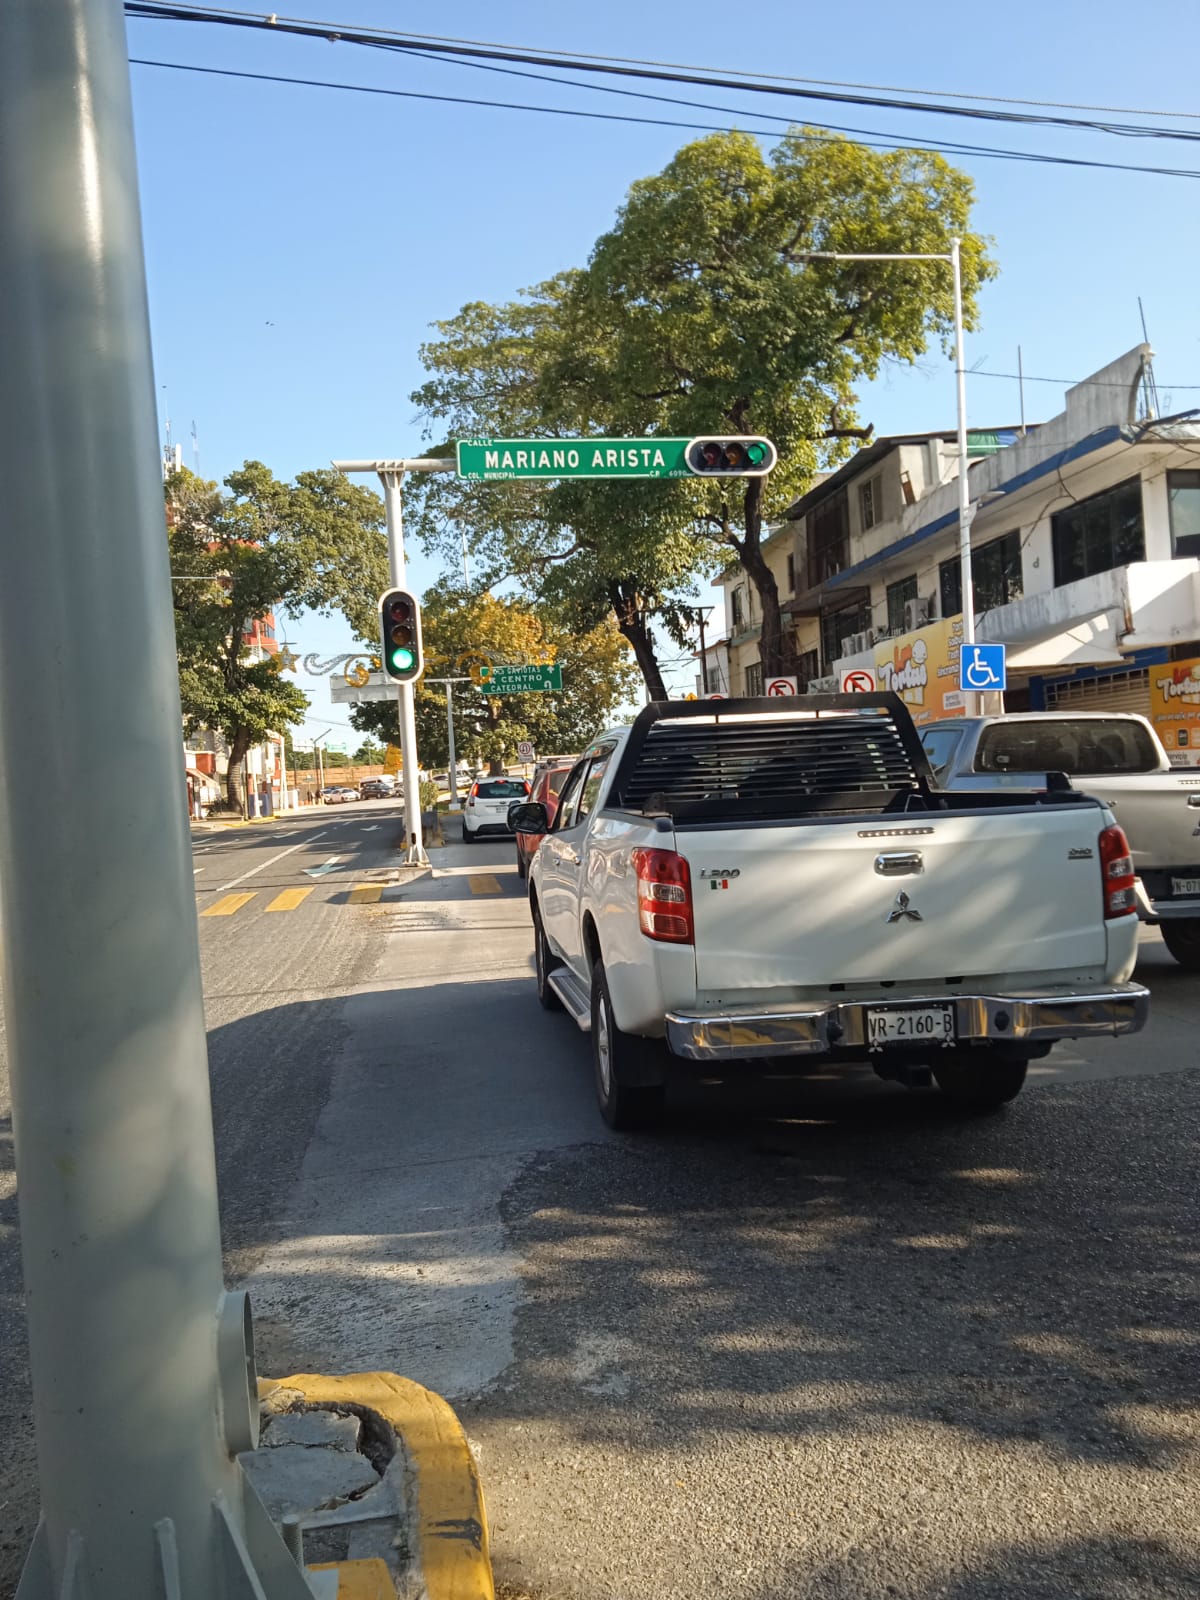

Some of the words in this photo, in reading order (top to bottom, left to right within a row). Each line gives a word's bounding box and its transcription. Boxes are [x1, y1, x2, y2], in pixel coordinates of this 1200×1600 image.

[485, 450, 580, 469] MARIANO
[591, 448, 666, 468] ARISTA
[484, 472, 517, 480] MUNICIPAL
[501, 674, 543, 683] CENTRO
[490, 684, 534, 692] CATEDRAL
[868, 1014, 952, 1037] VR-2160-B
